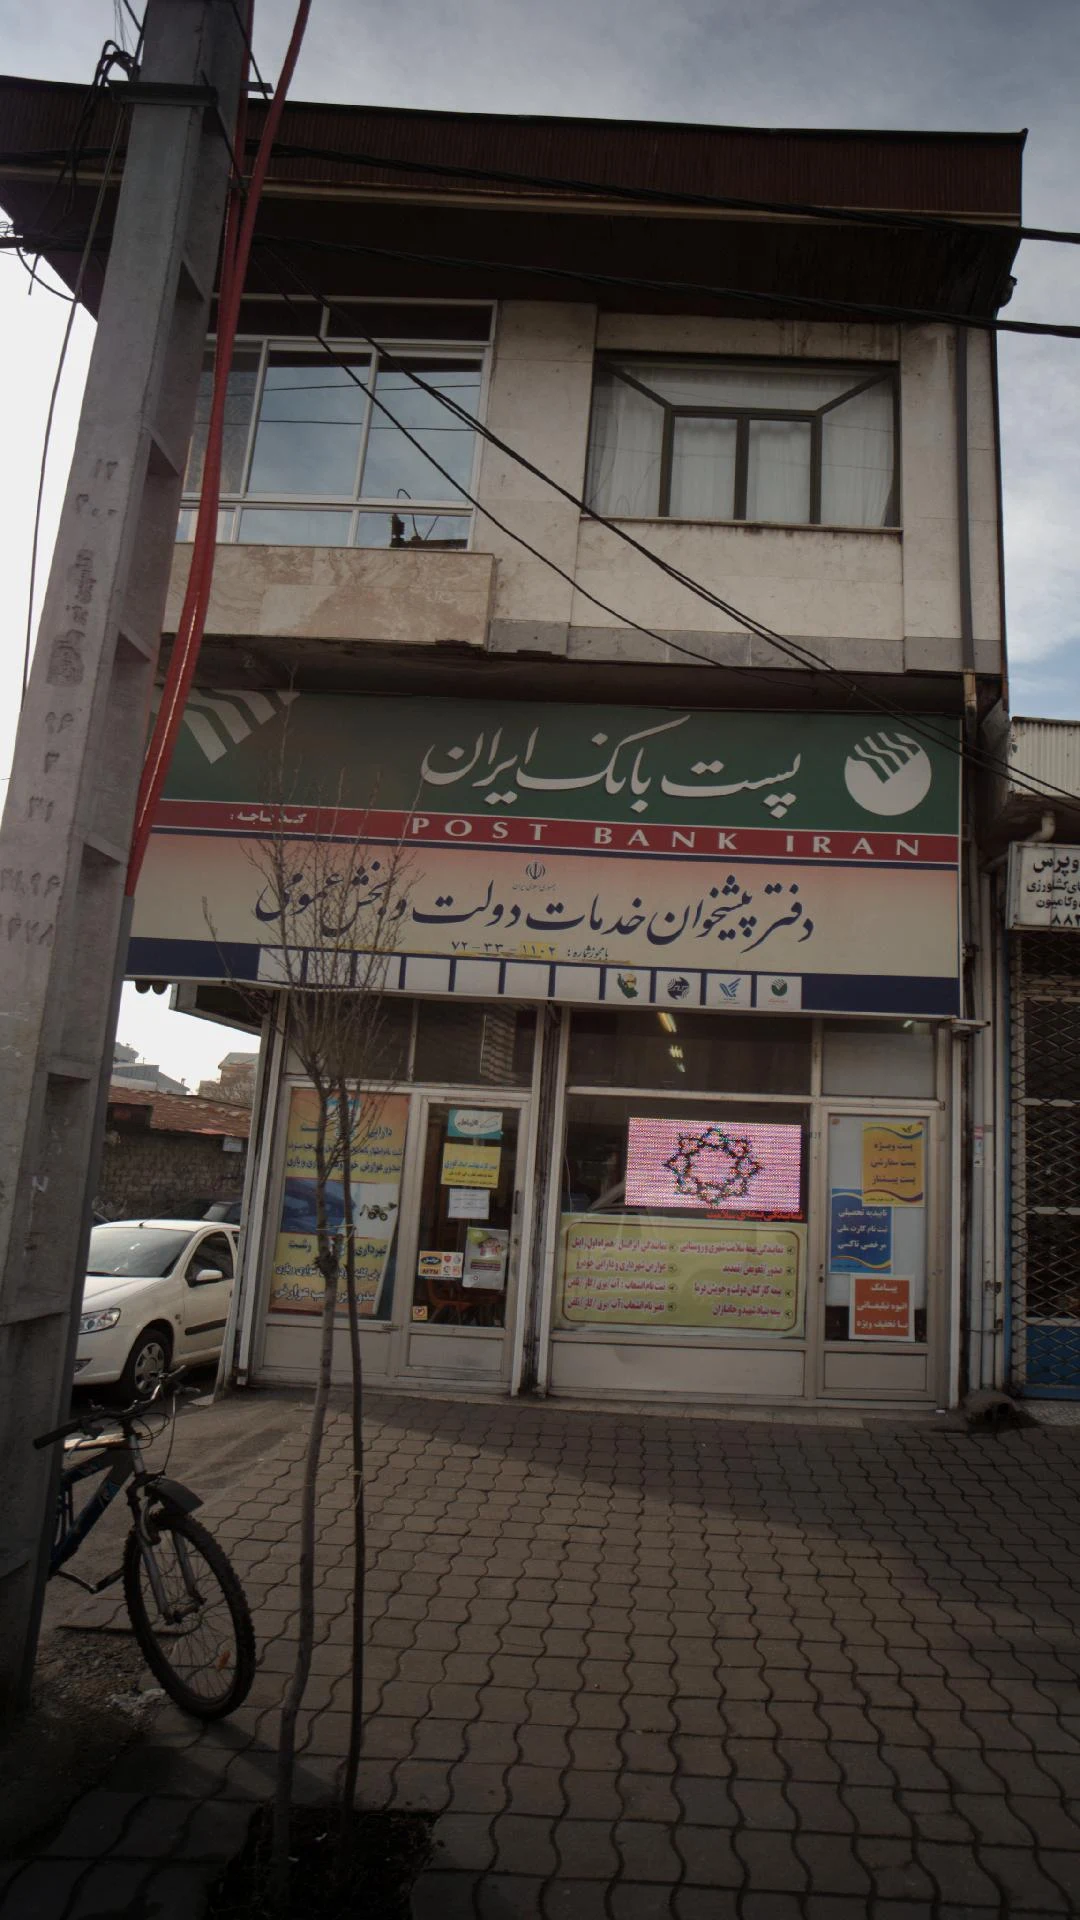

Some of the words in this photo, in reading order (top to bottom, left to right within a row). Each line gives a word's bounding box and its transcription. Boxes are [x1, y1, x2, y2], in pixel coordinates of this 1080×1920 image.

[420, 727, 539, 805] ایران
[516, 715, 690, 813] بانک
[661, 753, 801, 818] پست
[411, 816, 548, 841] POST
[594, 826, 737, 850] BANK
[786, 835, 919, 856] IRAN
[256, 871, 345, 922] عمومی
[321, 860, 396, 938] بخش
[389, 898, 407, 921] و
[413, 880, 522, 928] دولت
[526, 894, 646, 935] خدمات
[647, 875, 757, 945] پیشخوان
[741, 883, 814, 953] دفتر
[897, 1143, 912, 1152] پست
[900, 1161, 916, 1169] پست
[899, 1176, 916, 1186] پست
